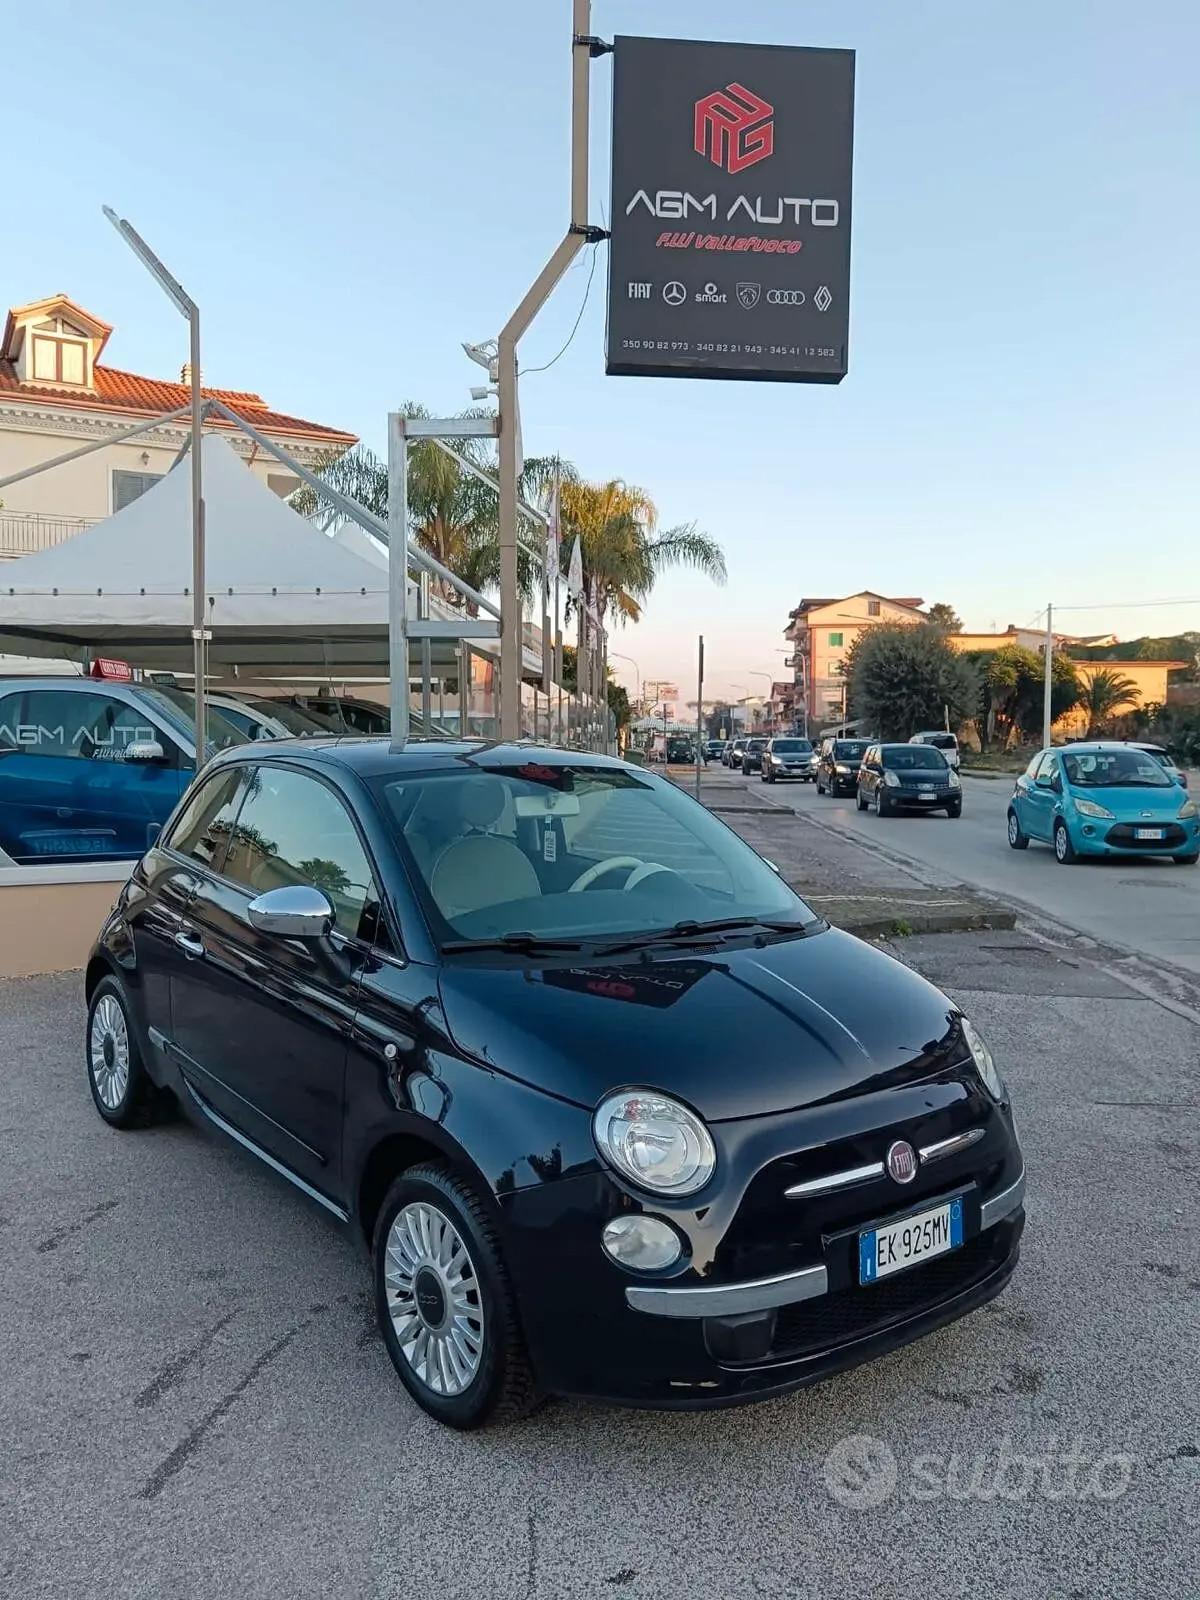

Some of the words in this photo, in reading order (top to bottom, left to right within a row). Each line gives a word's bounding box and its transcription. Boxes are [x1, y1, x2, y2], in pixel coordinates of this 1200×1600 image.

[626, 189, 717, 220] AGM
[727, 194, 839, 226] AUTO
[628, 282, 652, 299] FIAT
[695, 292, 728, 303] smart
[623, 340, 640, 349] 350
[643, 340, 655, 349] 90
[671, 342, 689, 351] 973
[696, 343, 714, 351] 340
[730, 344, 741, 353] 21
[744, 345, 762, 353] 943
[769, 346, 787, 355] 345
[789, 347, 800, 355] 41
[72, 725, 156, 745] AUTO
[893, 1151, 913, 1175] FIAT
[876, 1232, 897, 1268] EK
[902, 1212, 950, 1259] 925MV
